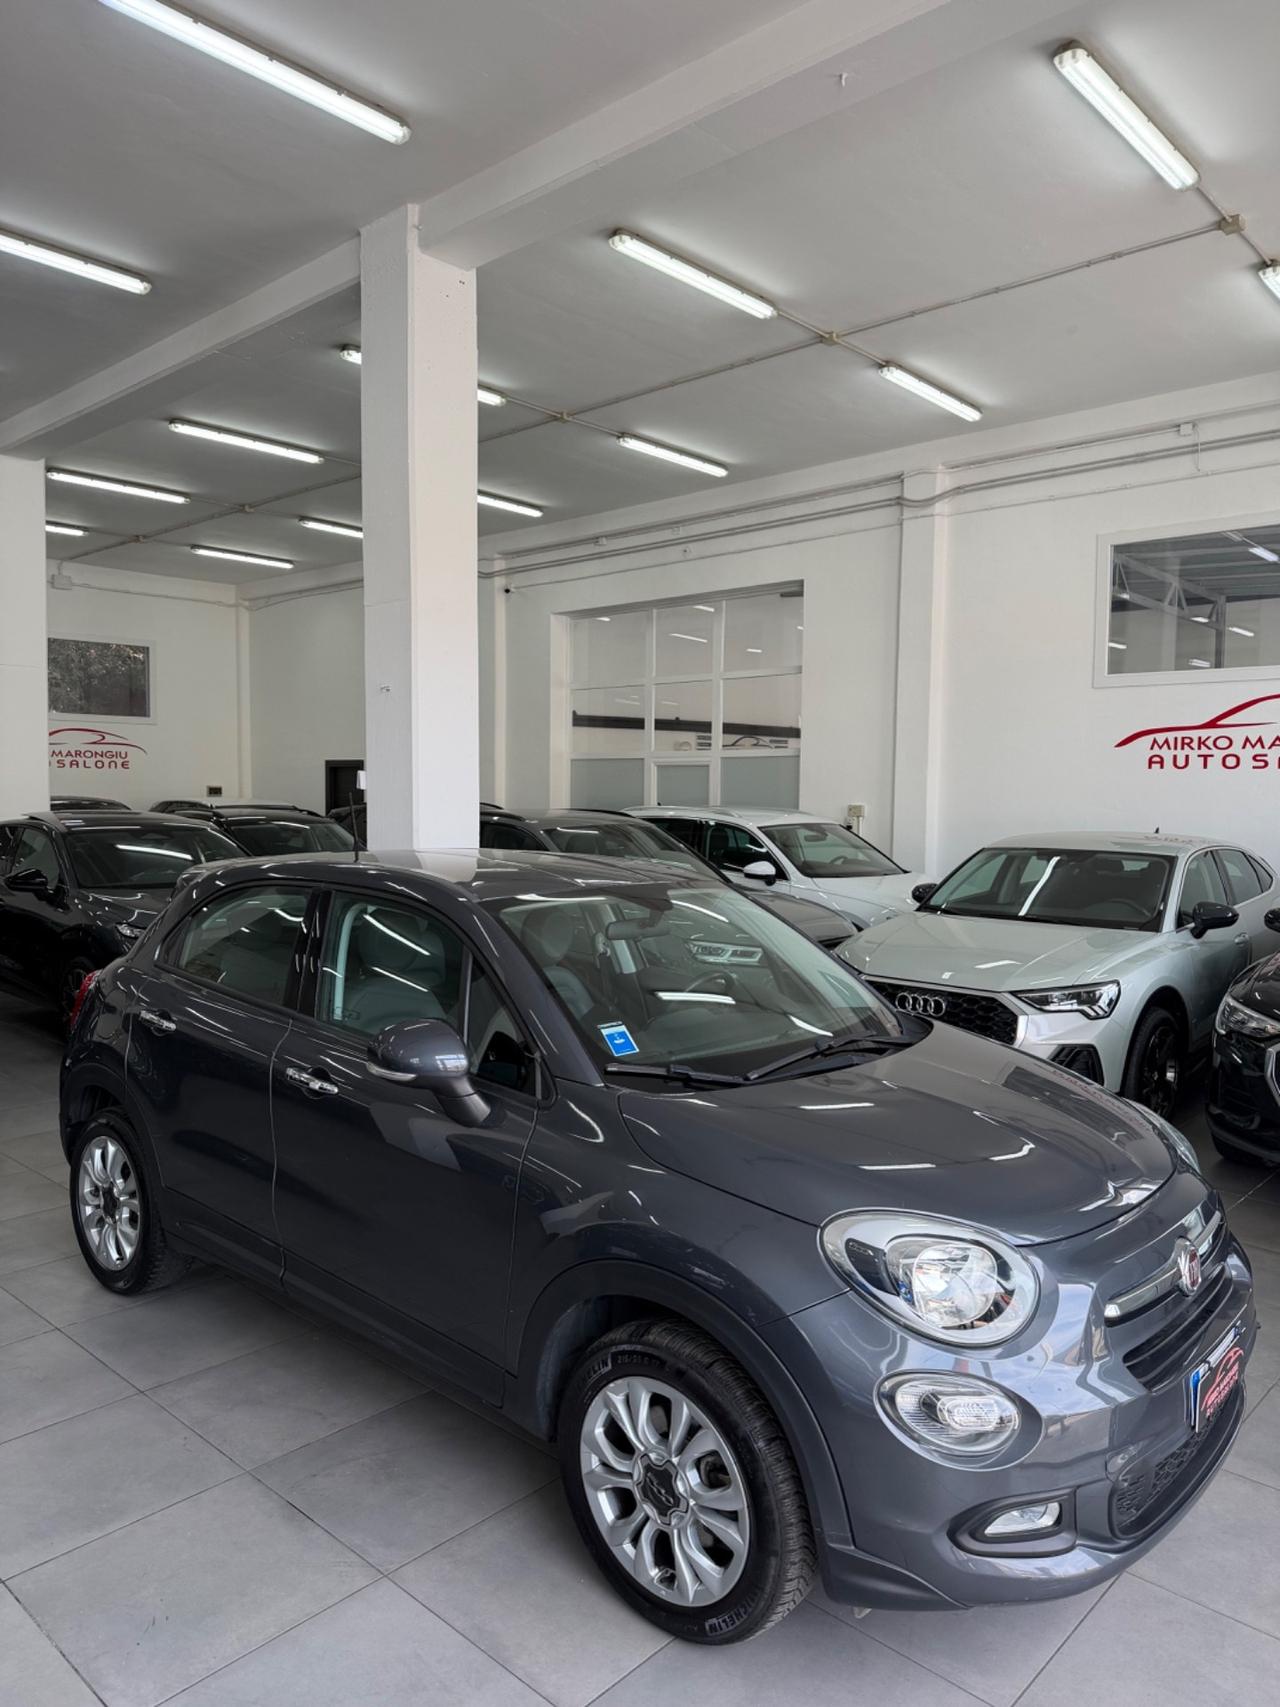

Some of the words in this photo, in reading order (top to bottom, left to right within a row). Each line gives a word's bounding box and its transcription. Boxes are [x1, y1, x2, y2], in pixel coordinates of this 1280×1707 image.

[1149, 735, 1234, 751] MIRKO
[51, 749, 128, 760] MARONGIU
[1147, 753, 1280, 770] AUTOS
